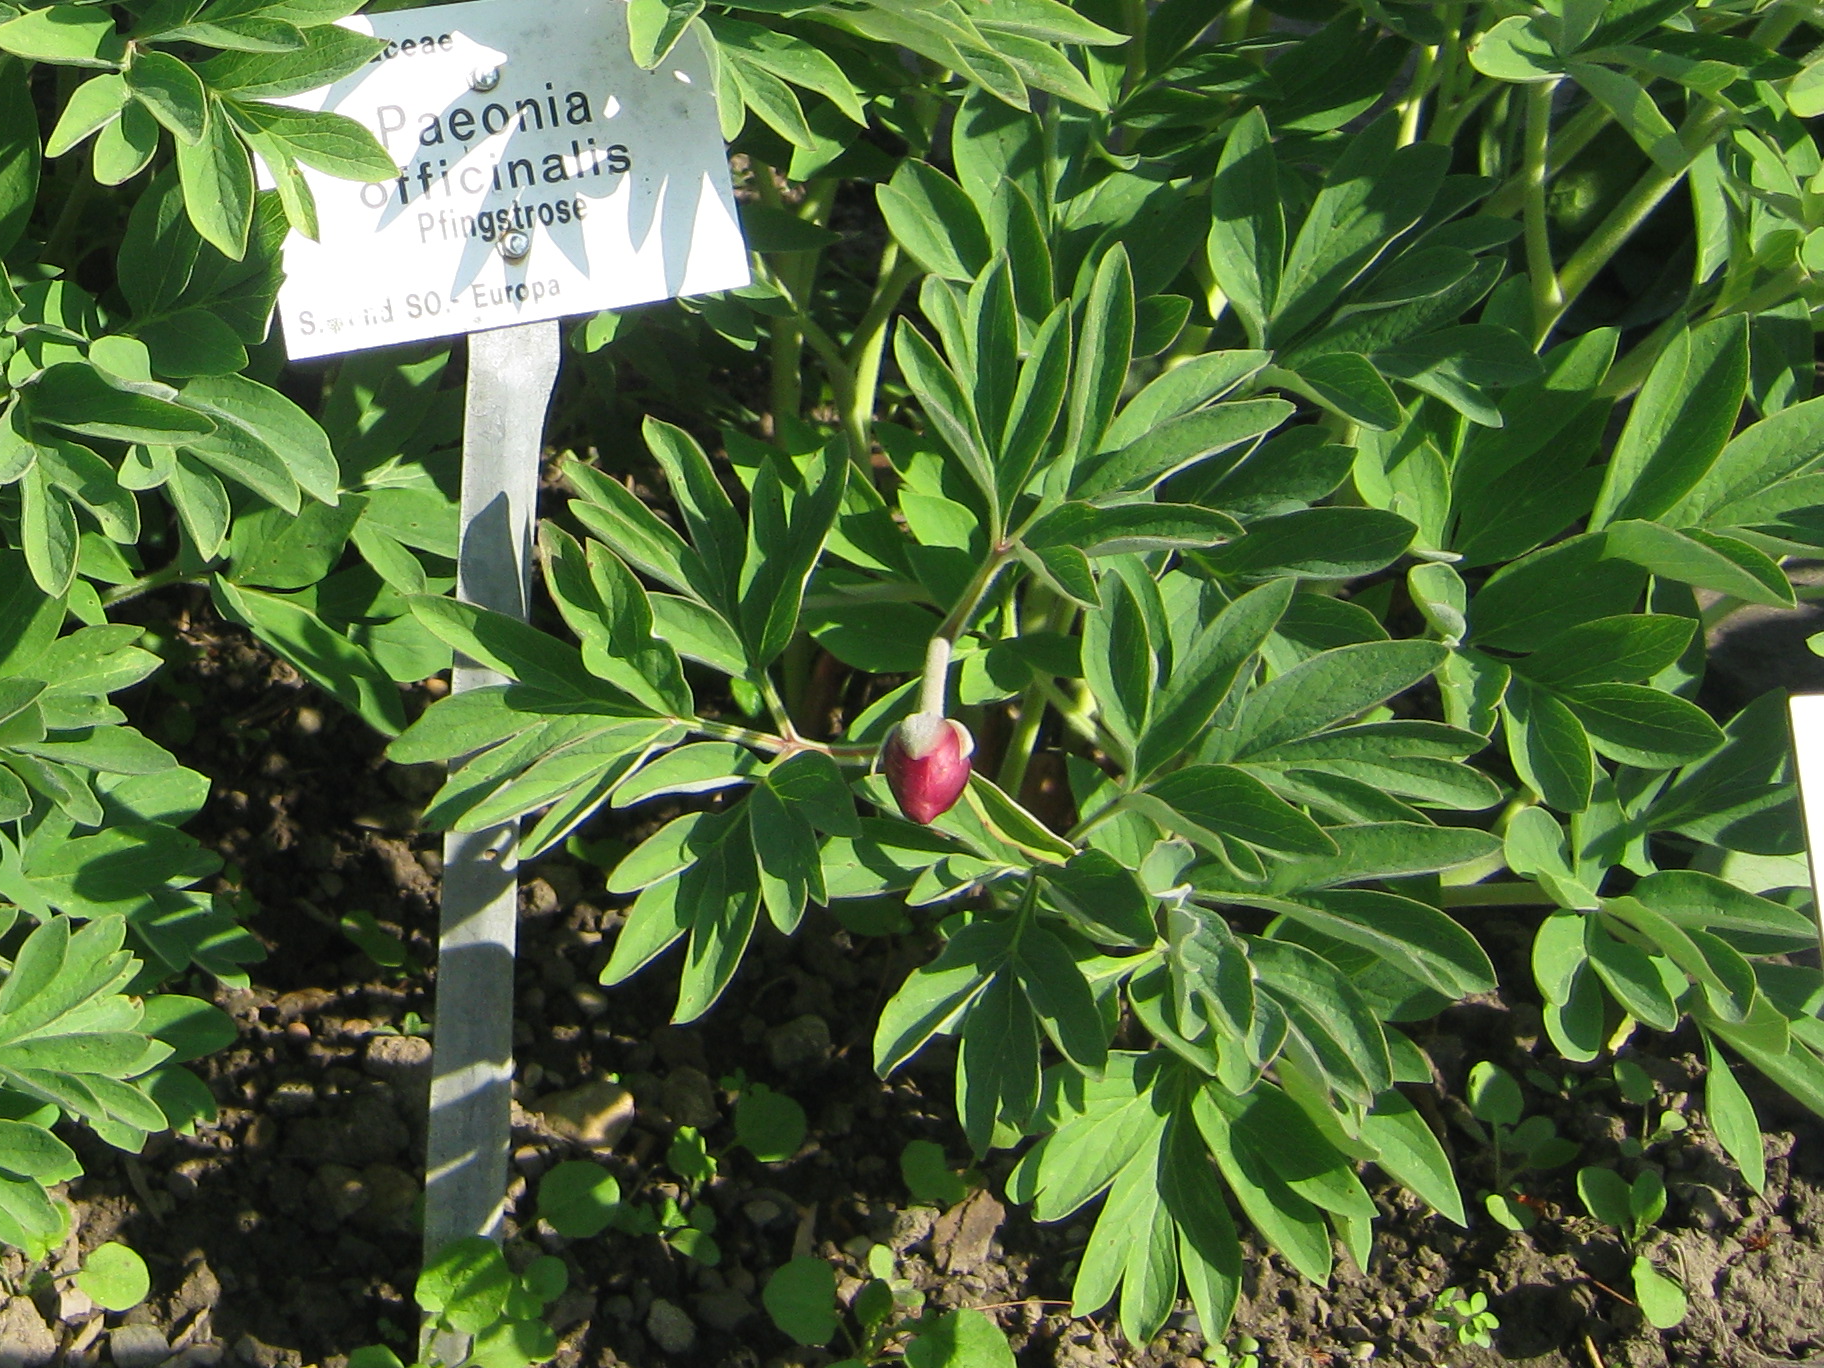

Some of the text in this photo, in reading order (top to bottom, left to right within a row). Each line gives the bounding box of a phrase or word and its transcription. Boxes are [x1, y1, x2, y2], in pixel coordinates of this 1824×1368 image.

[369, 33, 453, 63] ceae
[376, 82, 593, 151] Paeonia
[359, 138, 632, 209] officinalis
[417, 196, 588, 244] Pfingstrose
[471, 278, 562, 309] Europa
